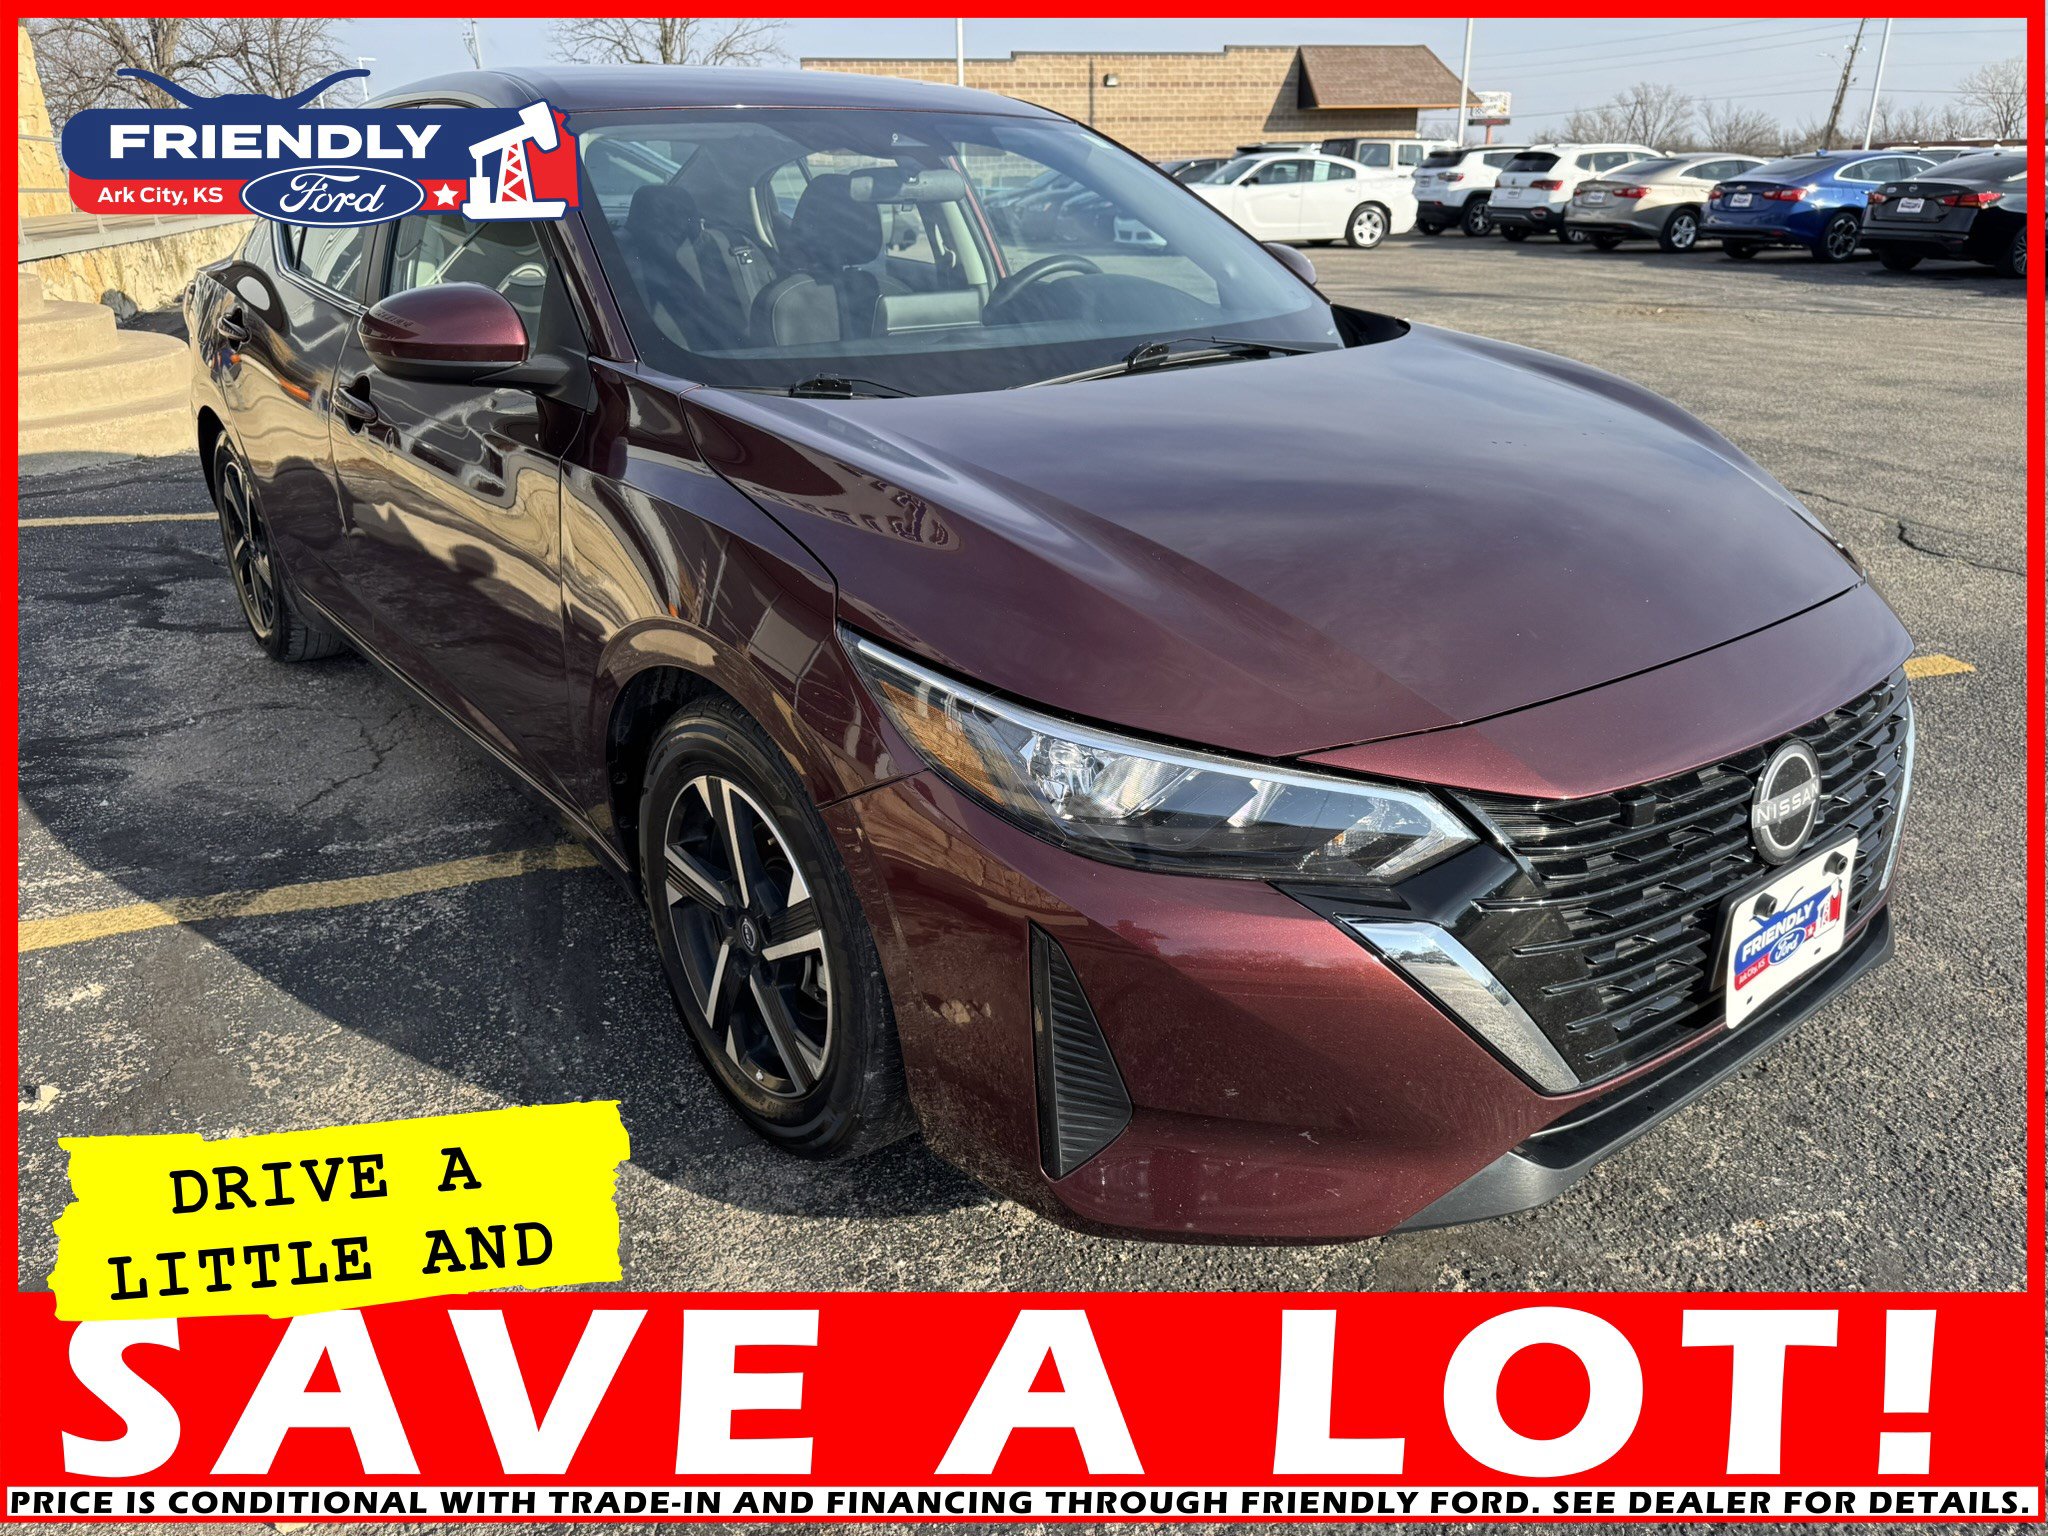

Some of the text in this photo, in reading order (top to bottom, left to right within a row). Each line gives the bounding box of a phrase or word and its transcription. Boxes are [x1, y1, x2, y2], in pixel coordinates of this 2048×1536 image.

[1756, 781, 1820, 824] NISSAN
[1741, 900, 1815, 963] FRIENDLY
[1774, 931, 1801, 962] Ford
